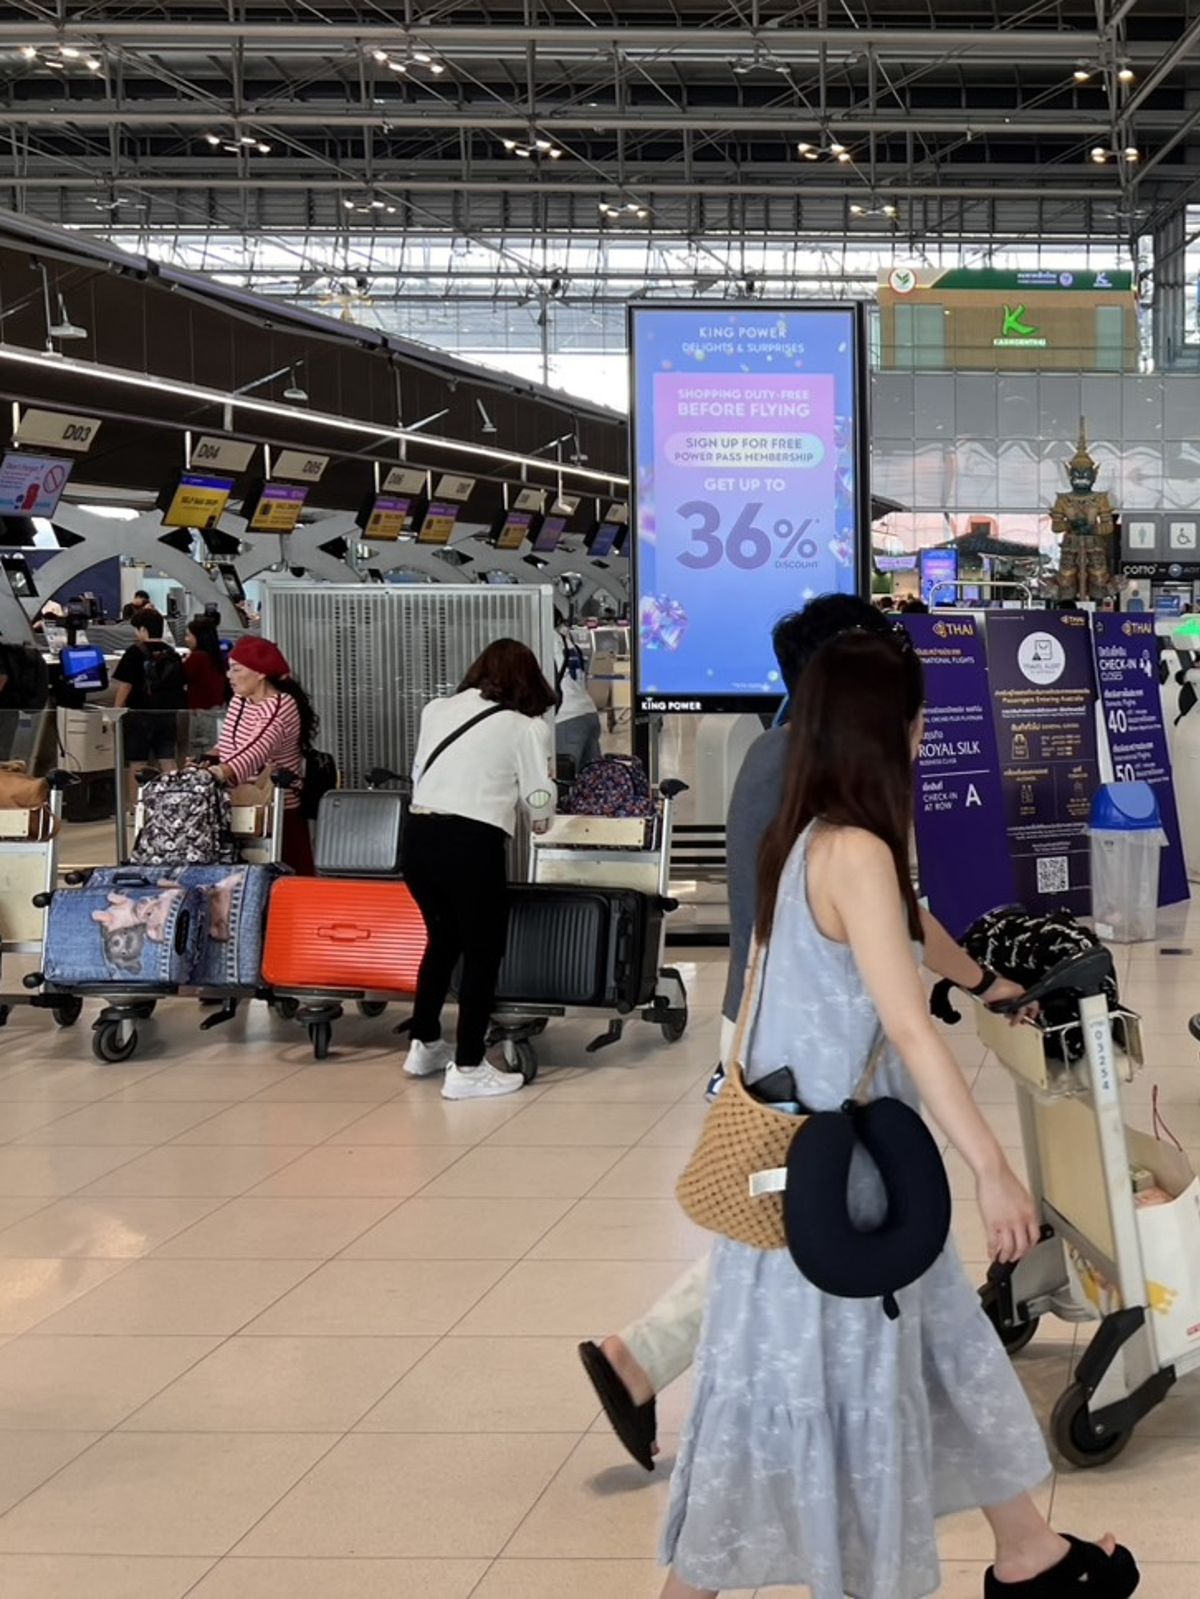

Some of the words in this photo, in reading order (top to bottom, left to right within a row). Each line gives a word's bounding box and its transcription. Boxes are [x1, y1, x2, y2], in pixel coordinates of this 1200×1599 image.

[699, 327, 734, 338] KING
[738, 327, 787, 338] POWER
[682, 343, 734, 353] DELIGHTS
[747, 343, 805, 353] SURPRISES
[677, 389, 741, 400] SHOPPING
[677, 403, 745, 417] BEFORE
[750, 403, 811, 417] FLYING
[62, 424, 92, 442] D03
[686, 437, 717, 449] SIGN
[720, 437, 739, 449] UP
[742, 437, 767, 449] FOR
[771, 437, 802, 449] FREE
[198, 443, 220, 459] D04
[674, 452, 713, 462] POWER
[715, 452, 742, 462] PASS
[744, 452, 814, 462] MEMBERSHIP
[704, 478, 735, 491] GET
[739, 478, 760, 491] UP
[764, 478, 786, 491] TO
[774, 561, 818, 569] DISCOUNT
[946, 623, 974, 635] THAI
[1131, 623, 1152, 634] THAI
[1099, 659, 1137, 671] CHECK-IN
[641, 697, 667, 711] KING
[668, 701, 702, 711] POWER
[1108, 709, 1127, 733] 40
[919, 742, 956, 757] ROYAL
[957, 741, 980, 755] SILK
[1116, 763, 1135, 781] 50
[923, 792, 958, 802] CHECK-IN
[965, 783, 982, 807] A
[924, 803, 934, 811] AT
